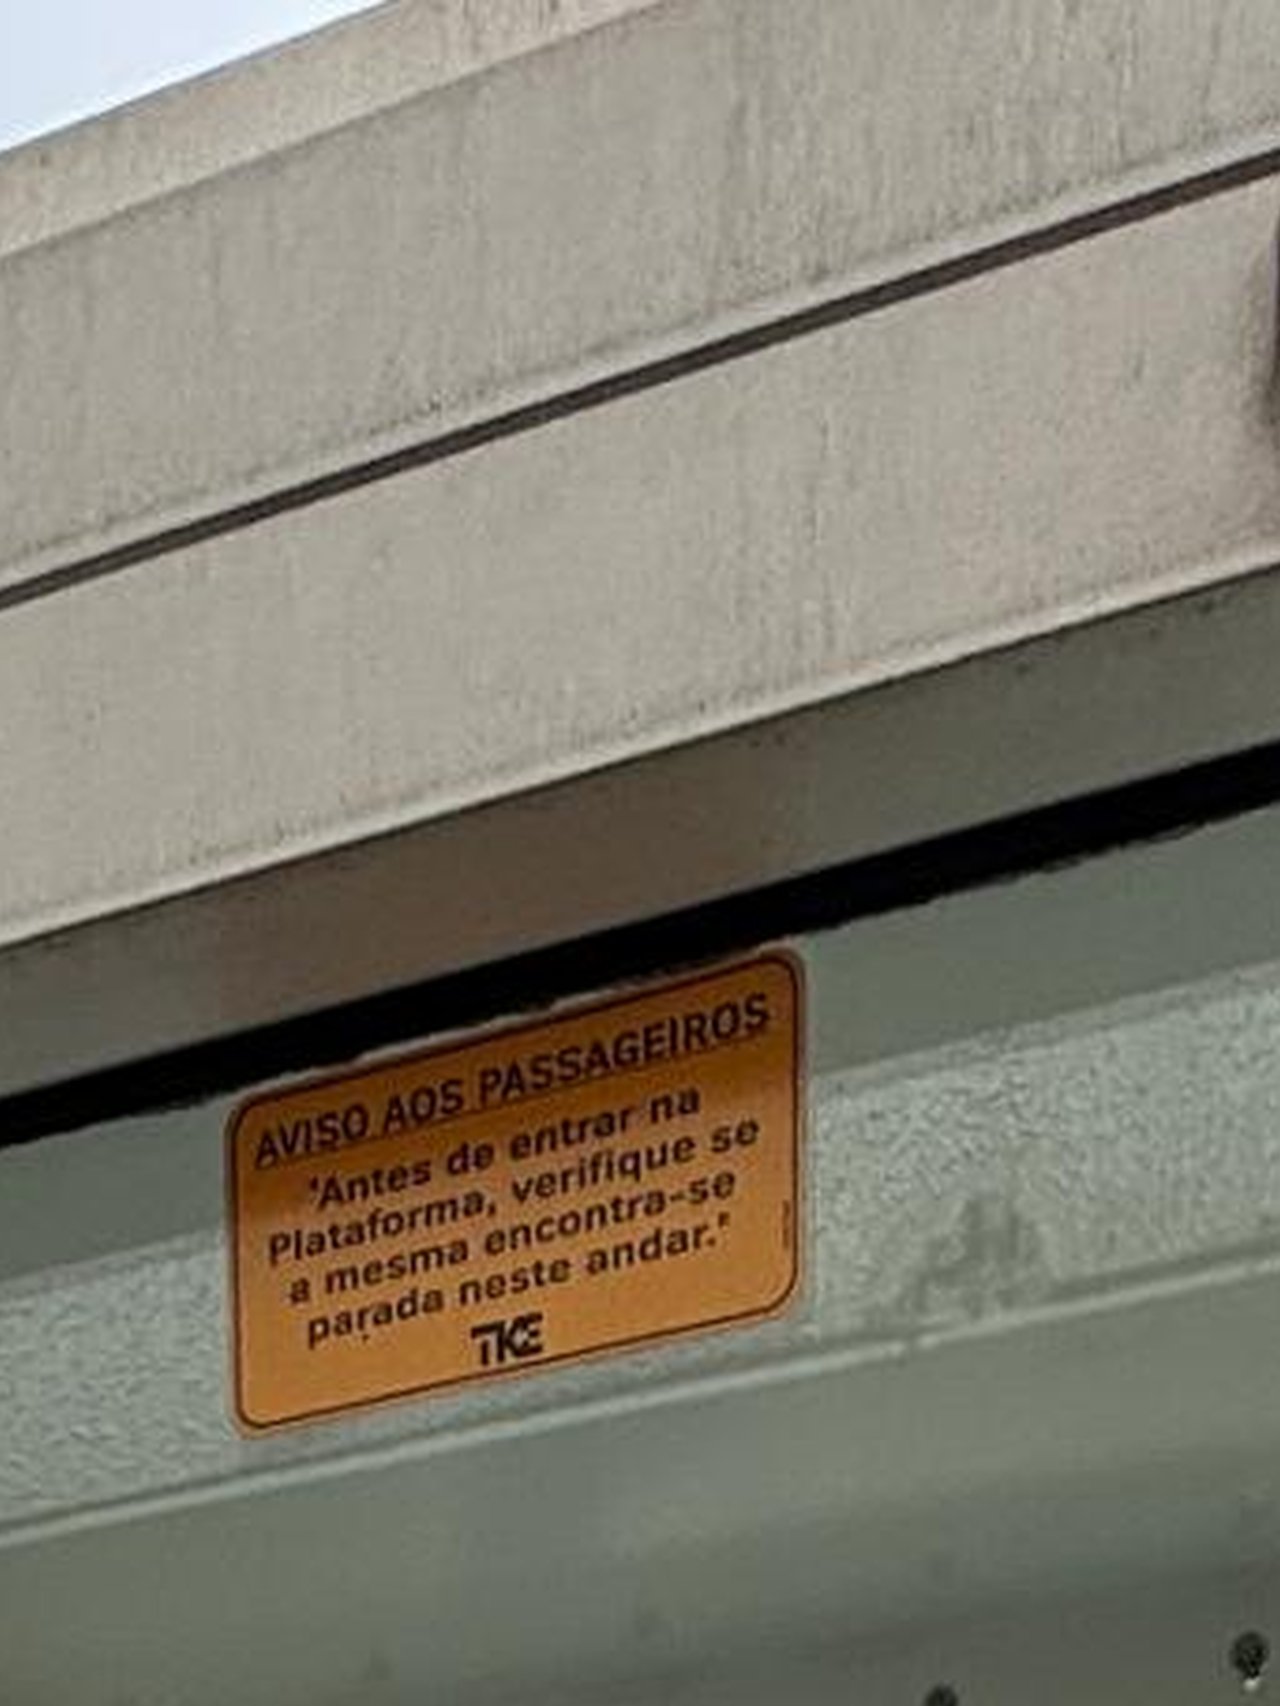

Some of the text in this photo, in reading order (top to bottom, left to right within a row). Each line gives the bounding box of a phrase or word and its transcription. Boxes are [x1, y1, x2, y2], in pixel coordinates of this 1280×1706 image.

[254, 993, 770, 1170] AVISO AOS PASSAGEIROS
[448, 1142, 494, 1175] de
[510, 1106, 633, 1159] entrar
[649, 1087, 700, 1123] na
[270, 1118, 760, 1267] Plataforma, verifique se
[288, 1277, 310, 1304] a
[325, 1240, 468, 1294] mesma
[485, 1171, 735, 1256] encontra-se
[309, 1288, 443, 1349] parada
[459, 1259, 571, 1305] neste
[470, 1313, 544, 1366] TKE
